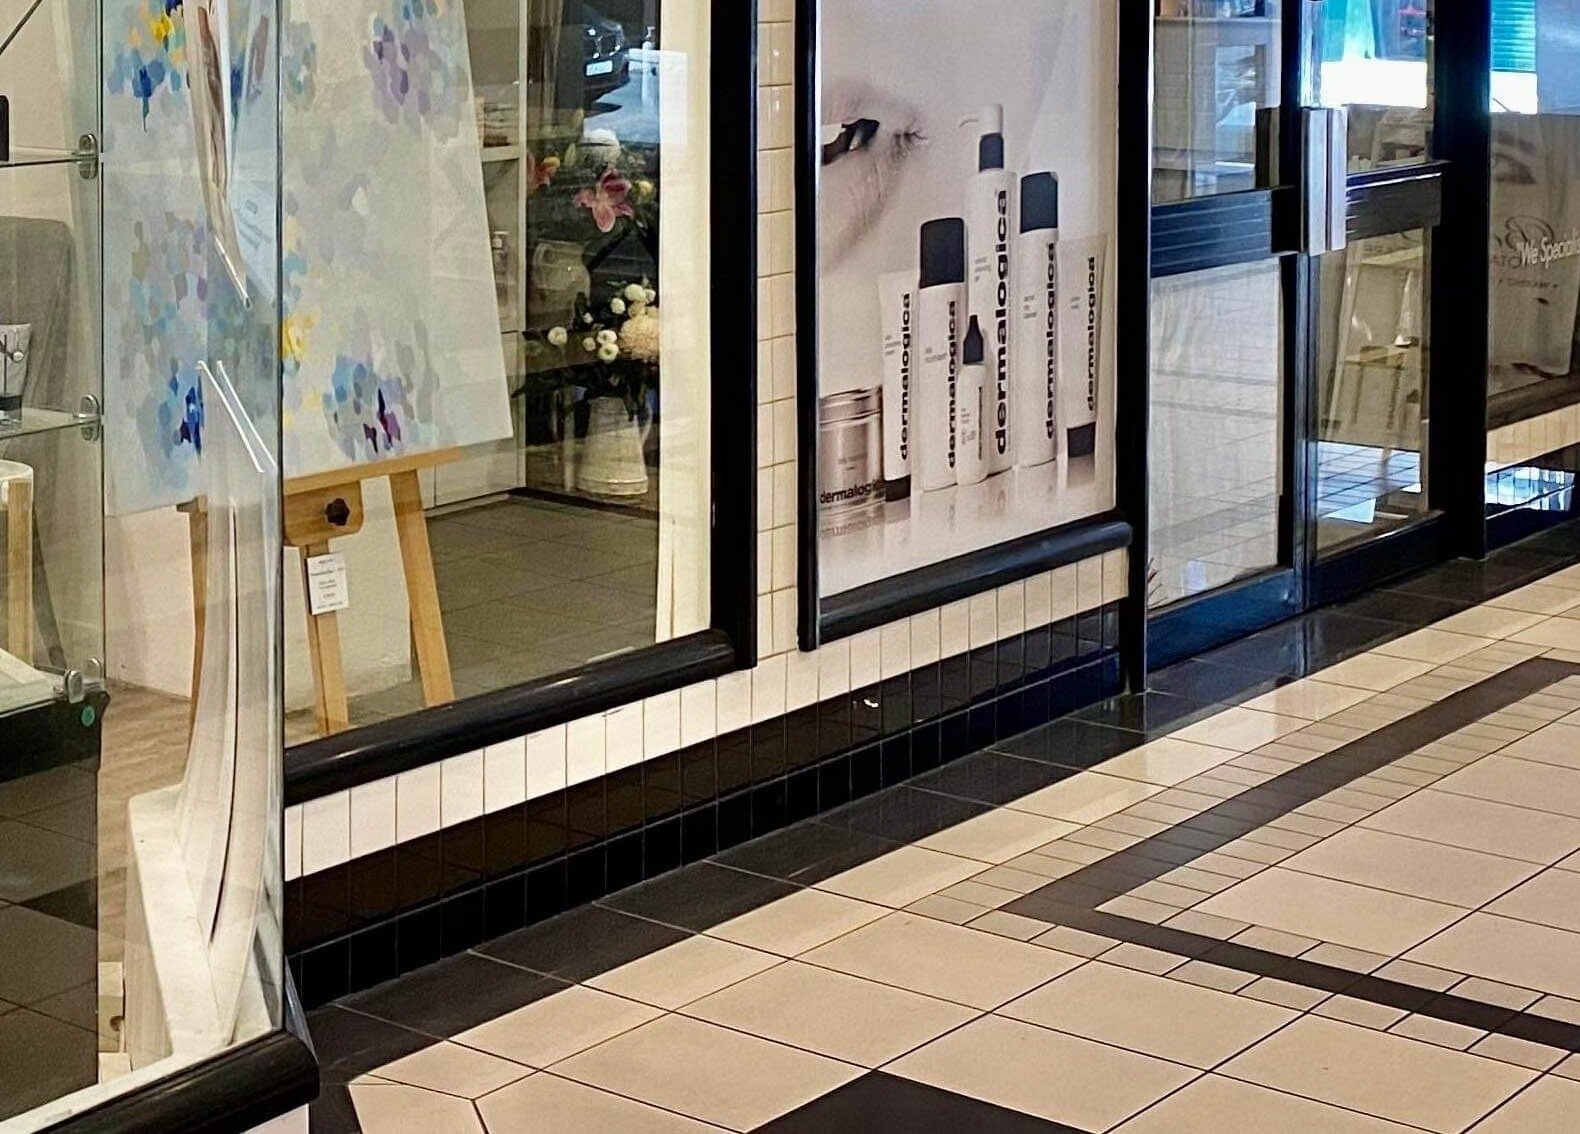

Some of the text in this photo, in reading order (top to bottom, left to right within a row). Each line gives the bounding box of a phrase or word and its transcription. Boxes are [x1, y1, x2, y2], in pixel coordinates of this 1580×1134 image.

[900, 293, 911, 461] dermalogica
[947, 300, 956, 468] dermalogica
[995, 189, 1008, 455] dermalogica
[1046, 243, 1055, 439] dermalogica
[1087, 257, 1096, 412] dermalogica
